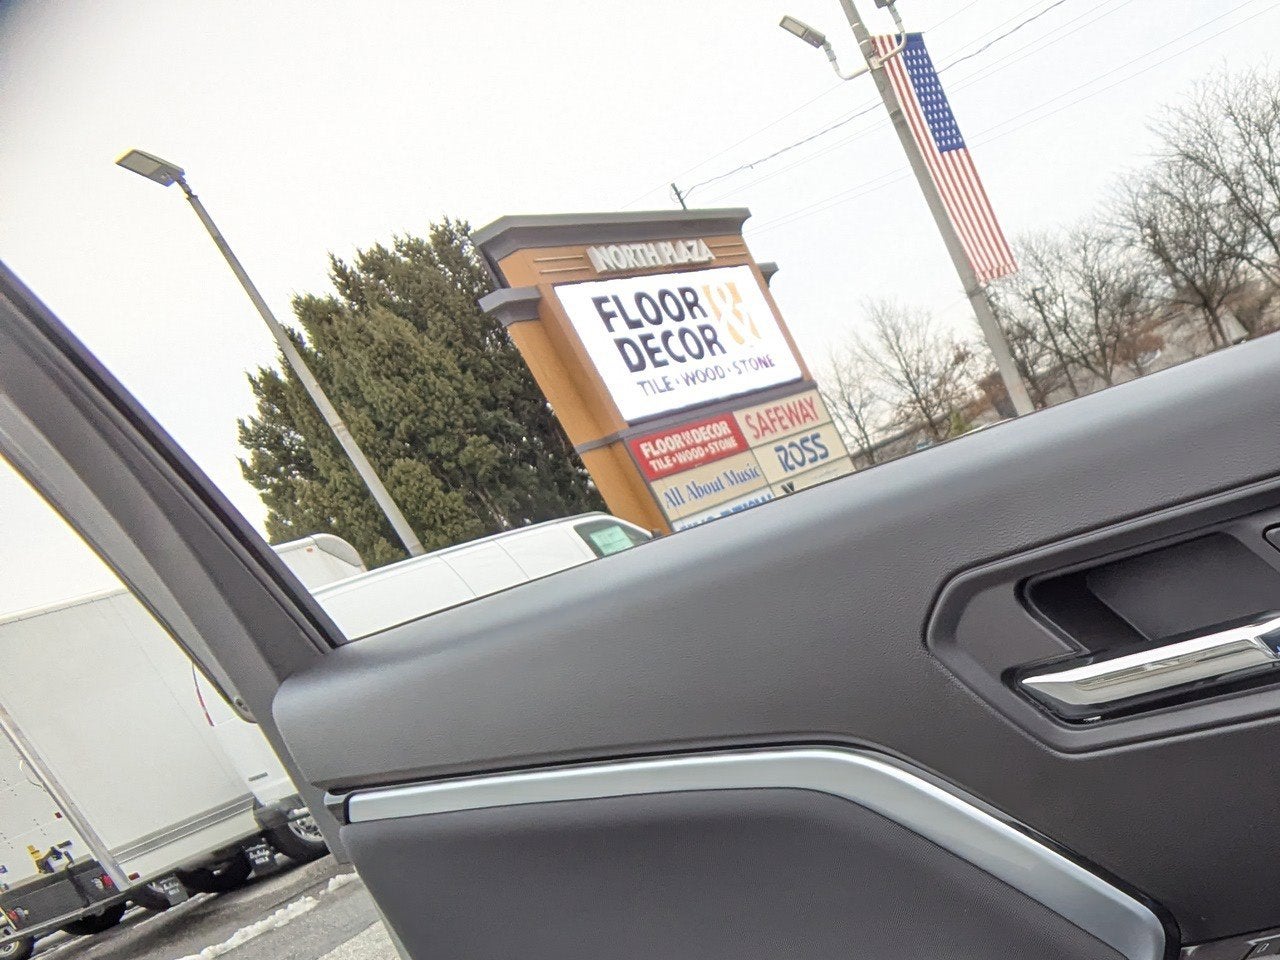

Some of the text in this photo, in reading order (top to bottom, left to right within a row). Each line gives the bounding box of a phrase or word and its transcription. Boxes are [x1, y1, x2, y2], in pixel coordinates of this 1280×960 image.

[586, 238, 716, 274] NORTH PLAZA
[591, 286, 709, 333] FLOOR
[613, 323, 728, 373] DECOR
[636, 354, 776, 397] TILE WOOD STONE
[744, 396, 820, 440] SAFEWAY
[774, 432, 830, 473] ROSS
[663, 463, 761, 510] All About Music
